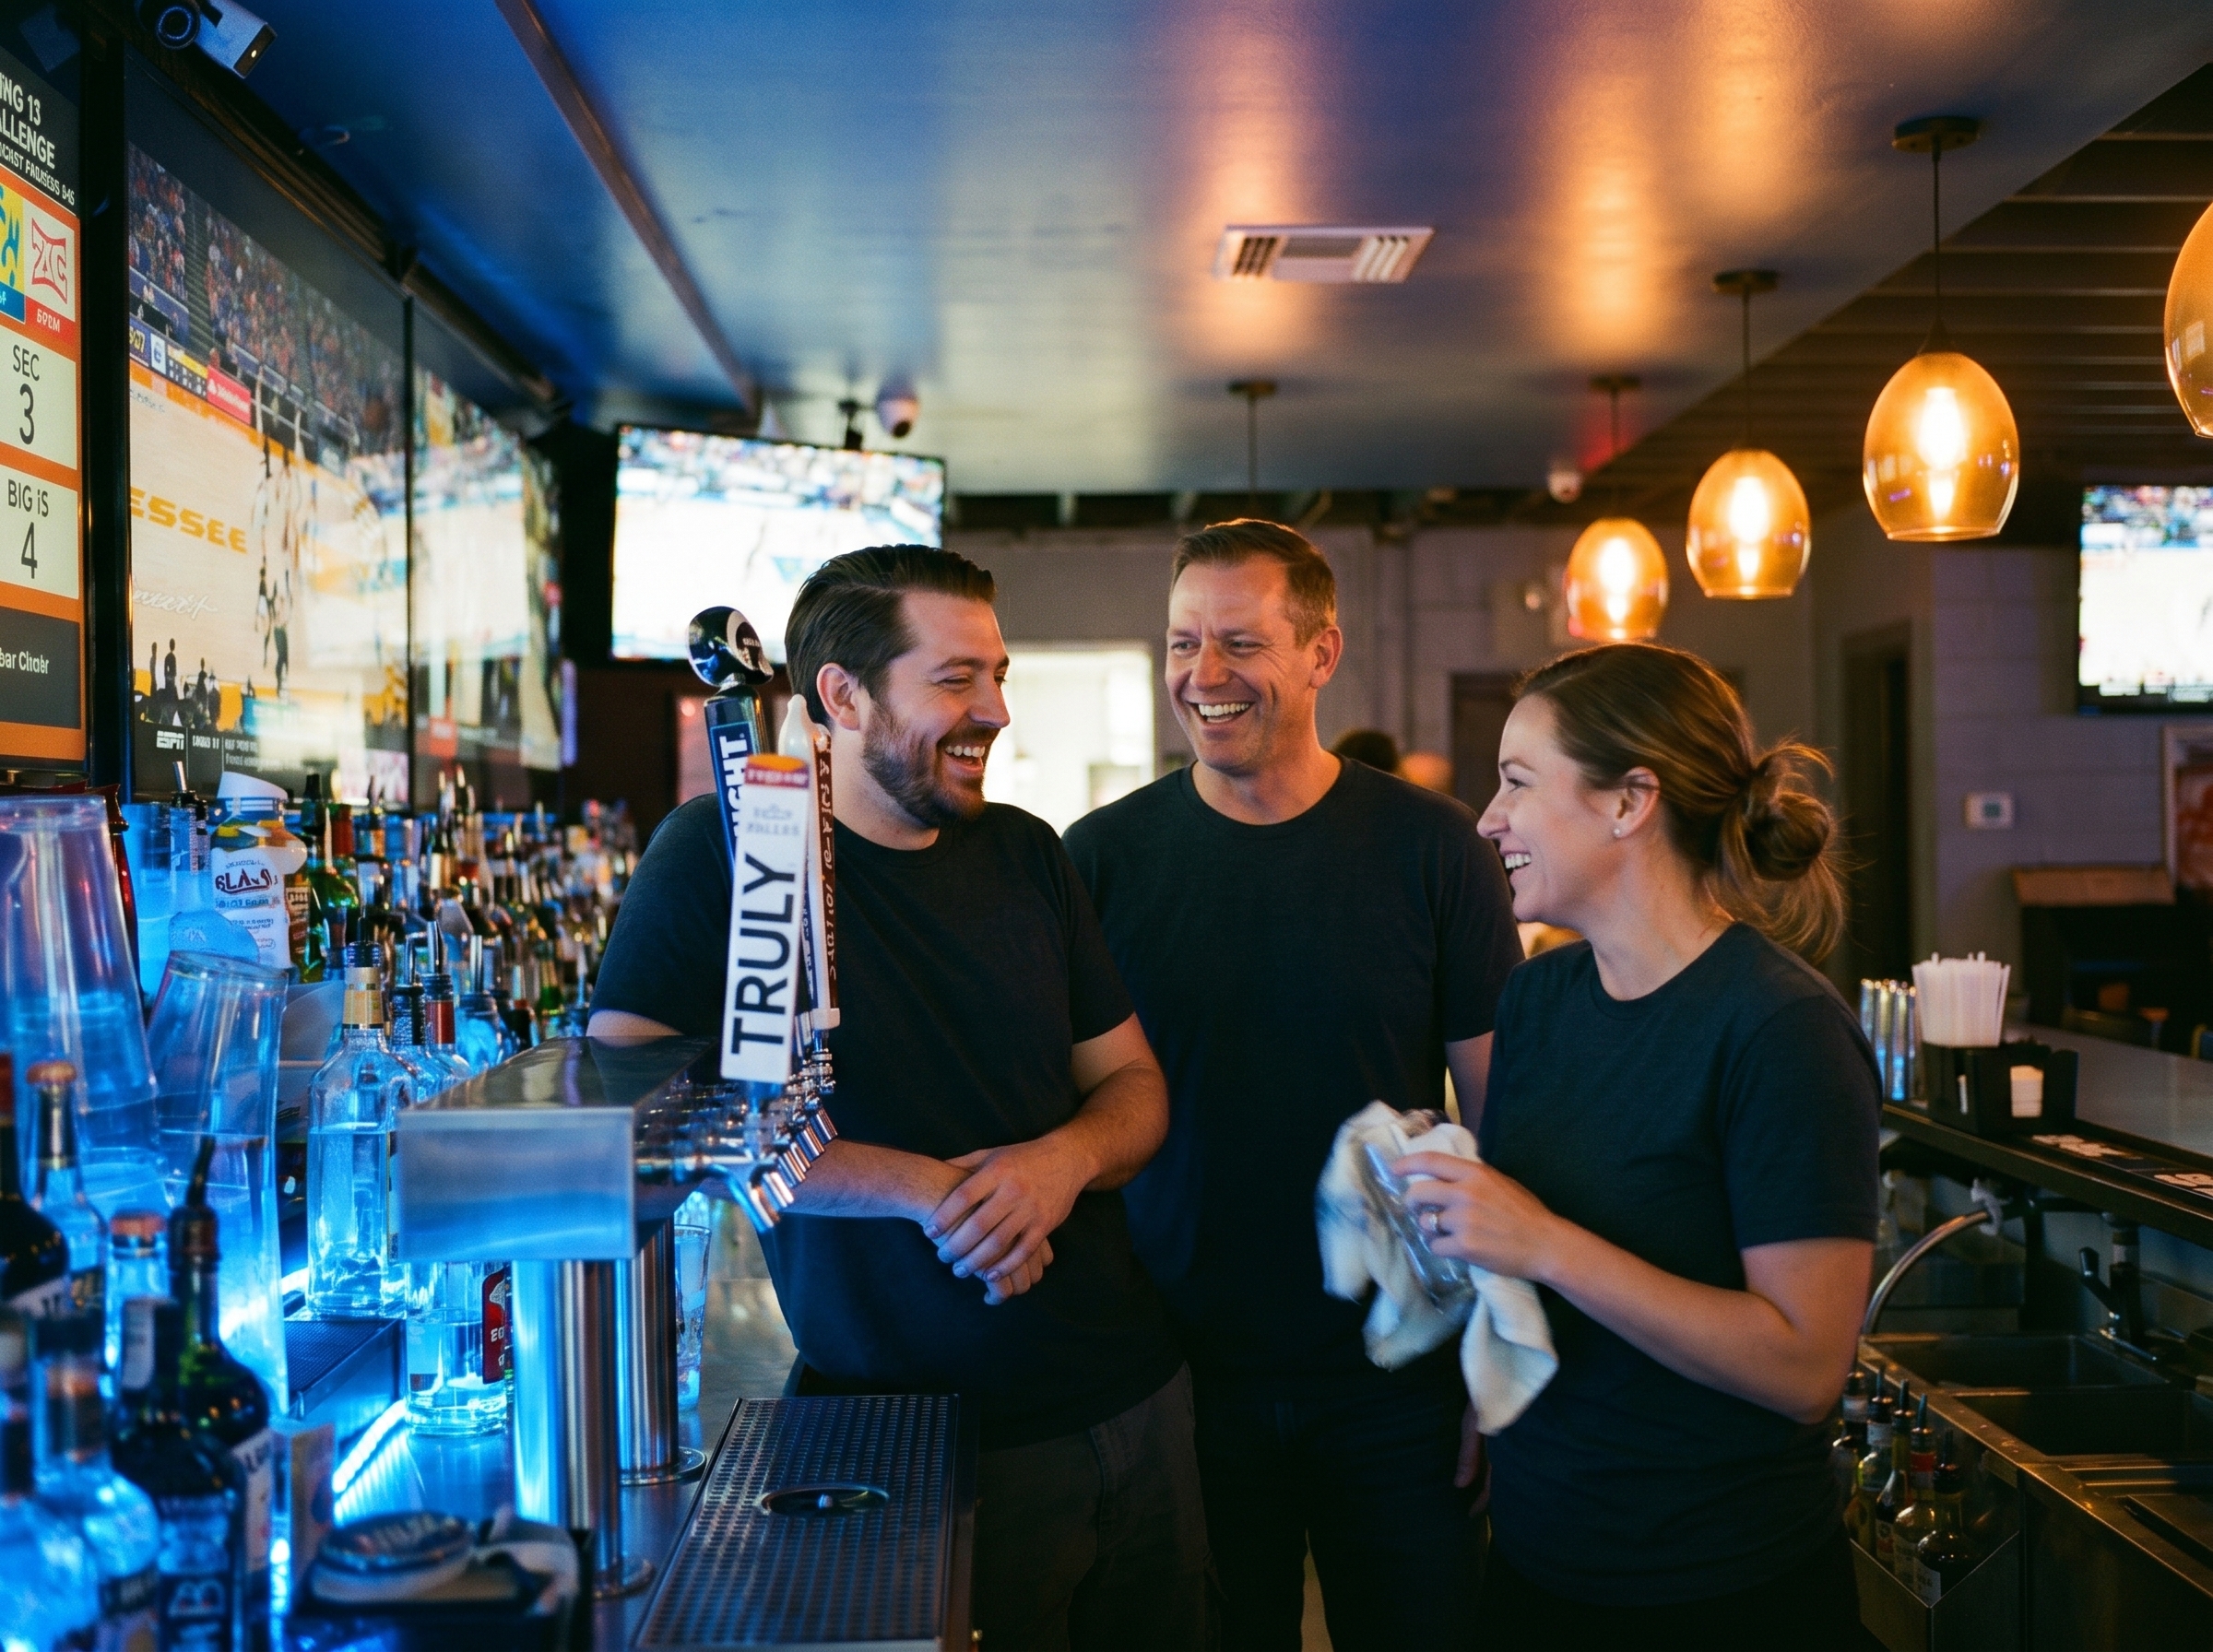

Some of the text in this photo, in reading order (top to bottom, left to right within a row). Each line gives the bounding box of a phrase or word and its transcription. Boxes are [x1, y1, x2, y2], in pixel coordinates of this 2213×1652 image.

[0, 108, 55, 170] LLENGE
[28, 94, 41, 126] 13
[13, 344, 41, 382] SEC
[19, 383, 35, 445] 3
[8, 478, 33, 513] BIG
[20, 521, 38, 580] 4
[730, 852, 797, 1056] TRULY
